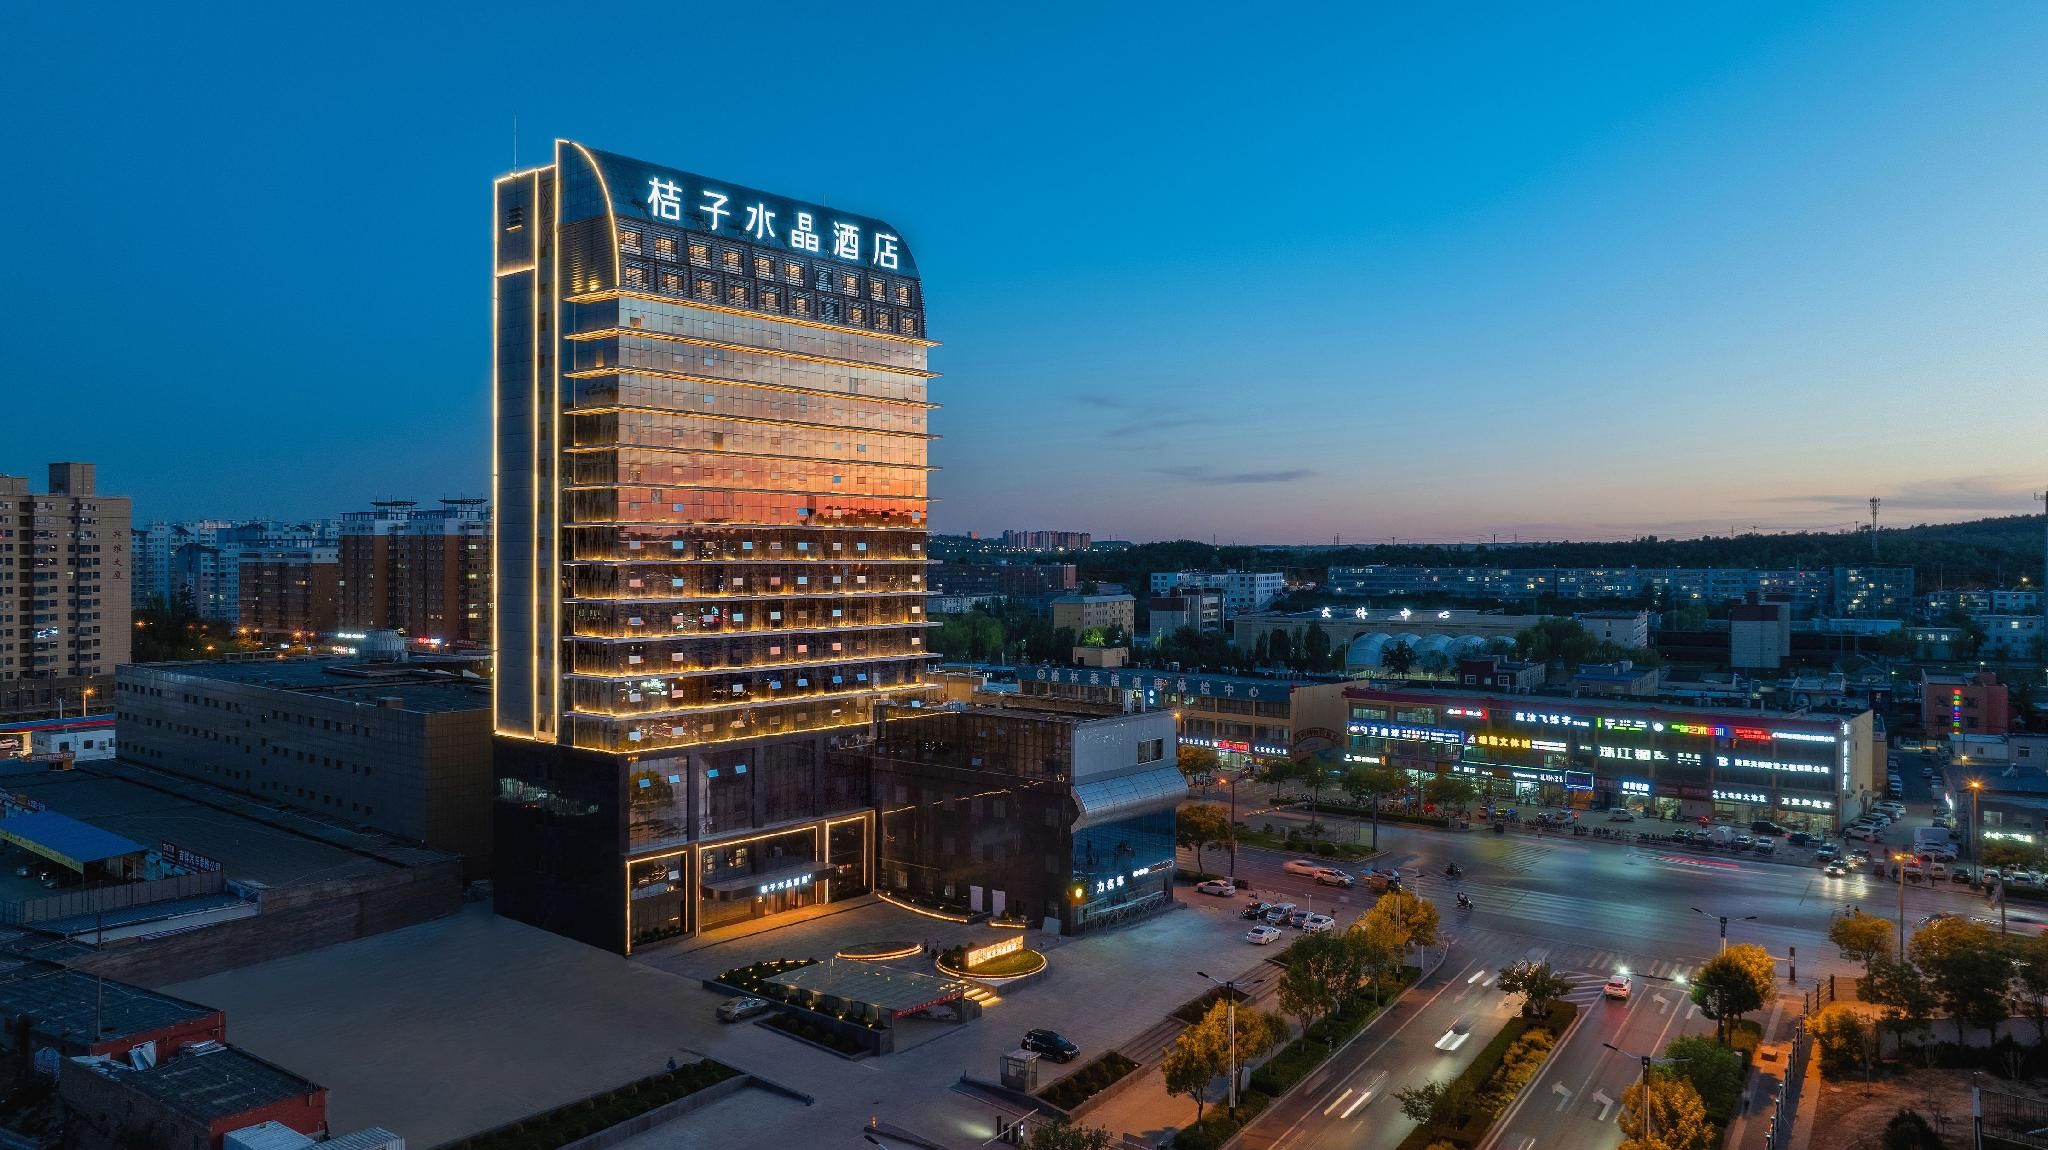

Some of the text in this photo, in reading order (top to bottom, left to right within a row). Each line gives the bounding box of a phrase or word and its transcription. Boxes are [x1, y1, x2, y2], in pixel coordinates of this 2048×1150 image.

[647, 176, 898, 270] 桔子水晶酒店
